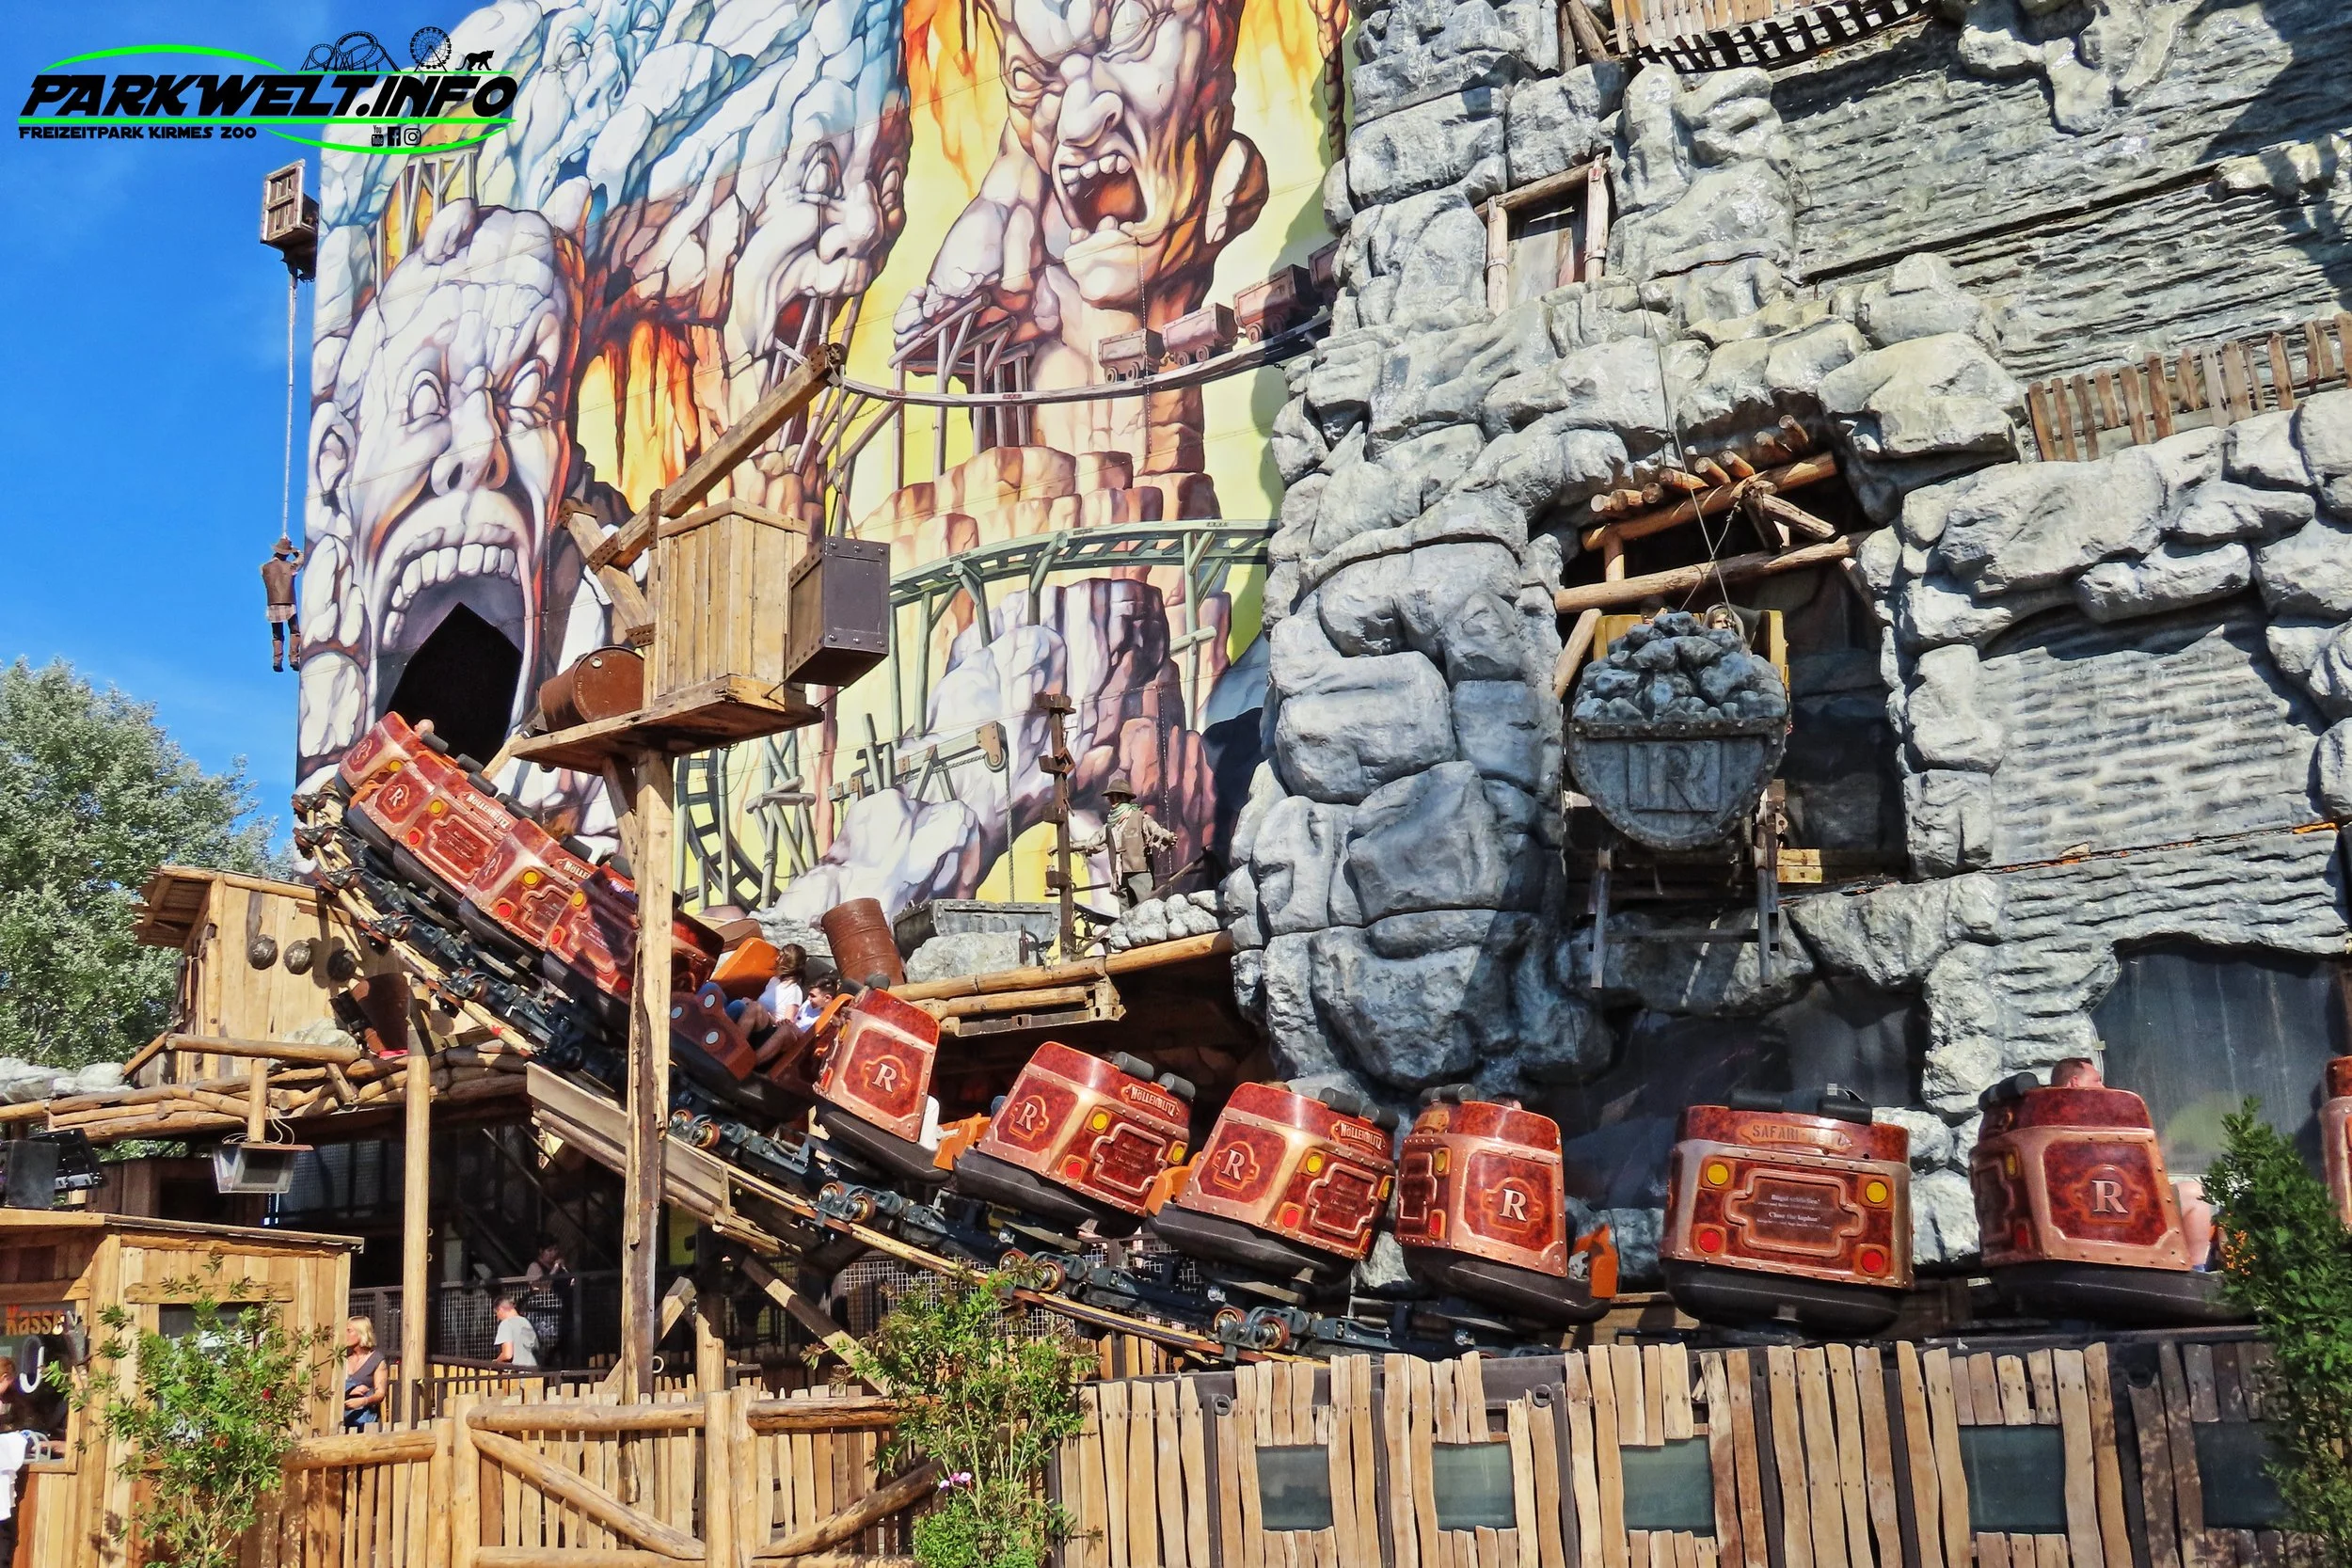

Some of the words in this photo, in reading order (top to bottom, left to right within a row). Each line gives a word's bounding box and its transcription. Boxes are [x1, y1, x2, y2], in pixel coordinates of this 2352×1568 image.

[388, 787, 405, 808] R
[871, 1062, 898, 1093] R
[1016, 1101, 1038, 1132] R
[1221, 1148, 1247, 1180] R
[1499, 1188, 1528, 1222] R
[2091, 1180, 2129, 1213] R
